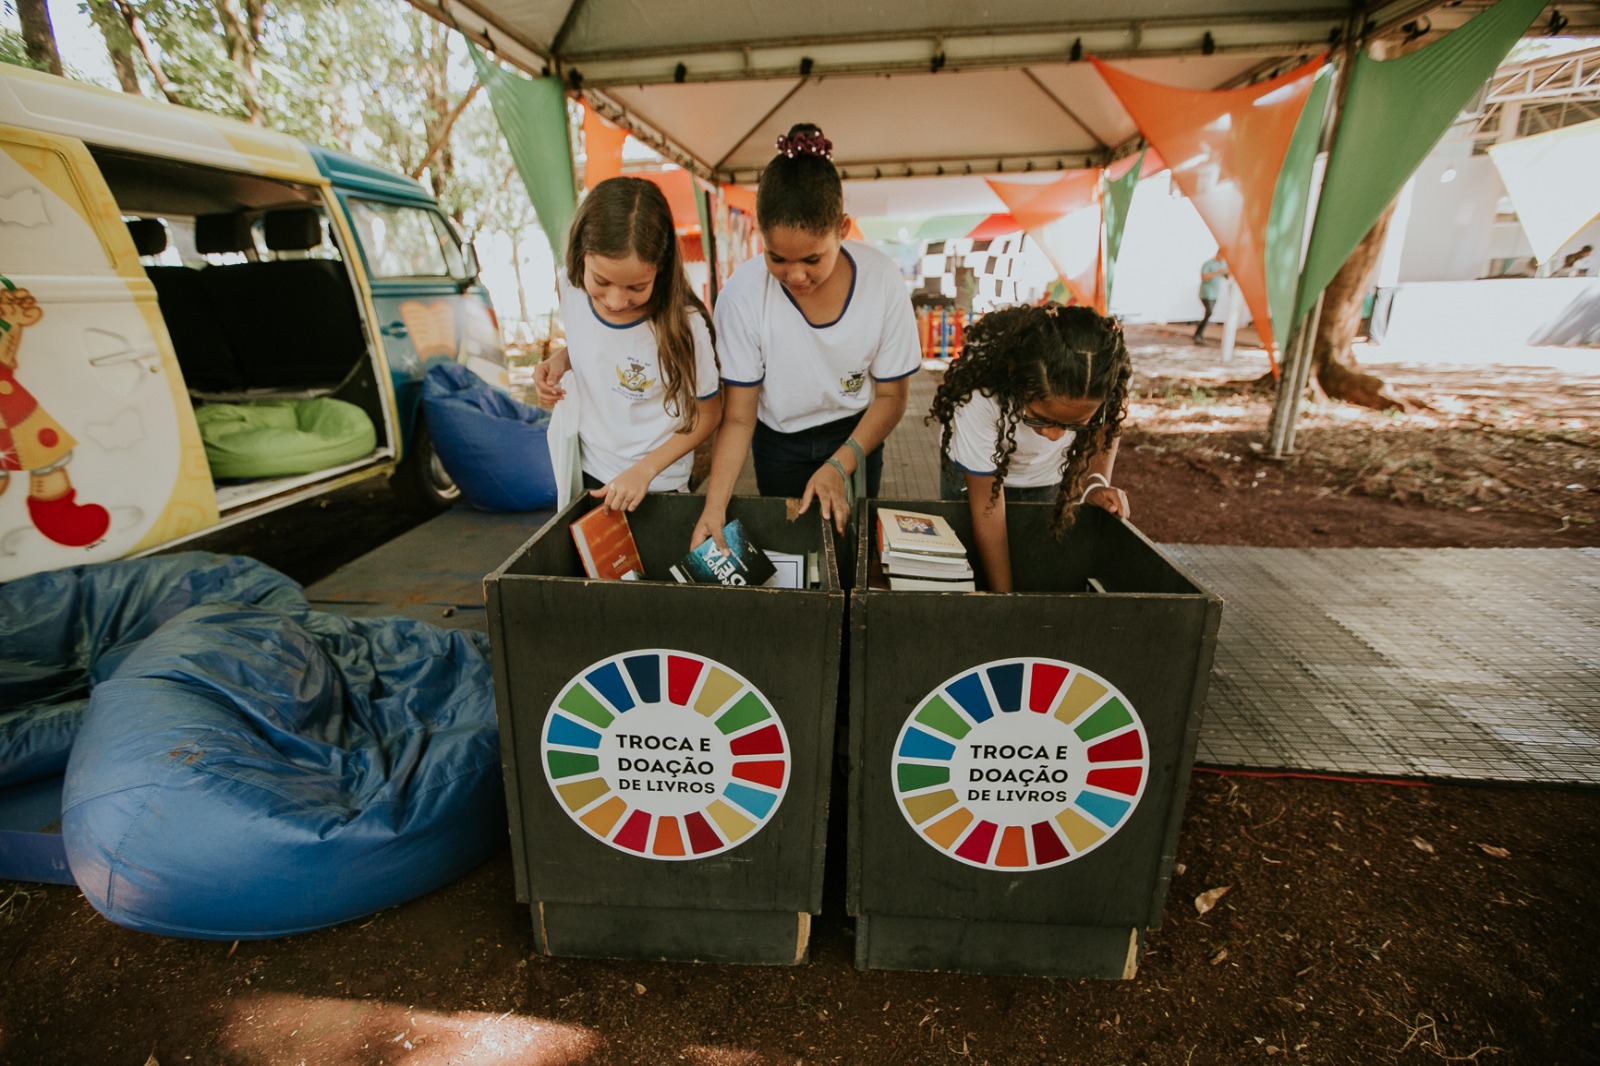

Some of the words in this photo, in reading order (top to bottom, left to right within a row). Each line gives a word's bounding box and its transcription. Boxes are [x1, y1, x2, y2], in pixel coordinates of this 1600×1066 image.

[702, 552, 730, 585] RANDE
[615, 734, 694, 752] TROCA
[699, 737, 711, 752] E
[969, 744, 1050, 760] TROCA
[1055, 745, 1068, 760] E
[617, 756, 714, 778] DOAÇÃO
[969, 764, 1069, 787] DOAÇÃO
[618, 778, 641, 790] DE
[646, 779, 716, 794] LIVROS
[967, 789, 991, 801] DE
[996, 789, 1067, 803] LIVROS
